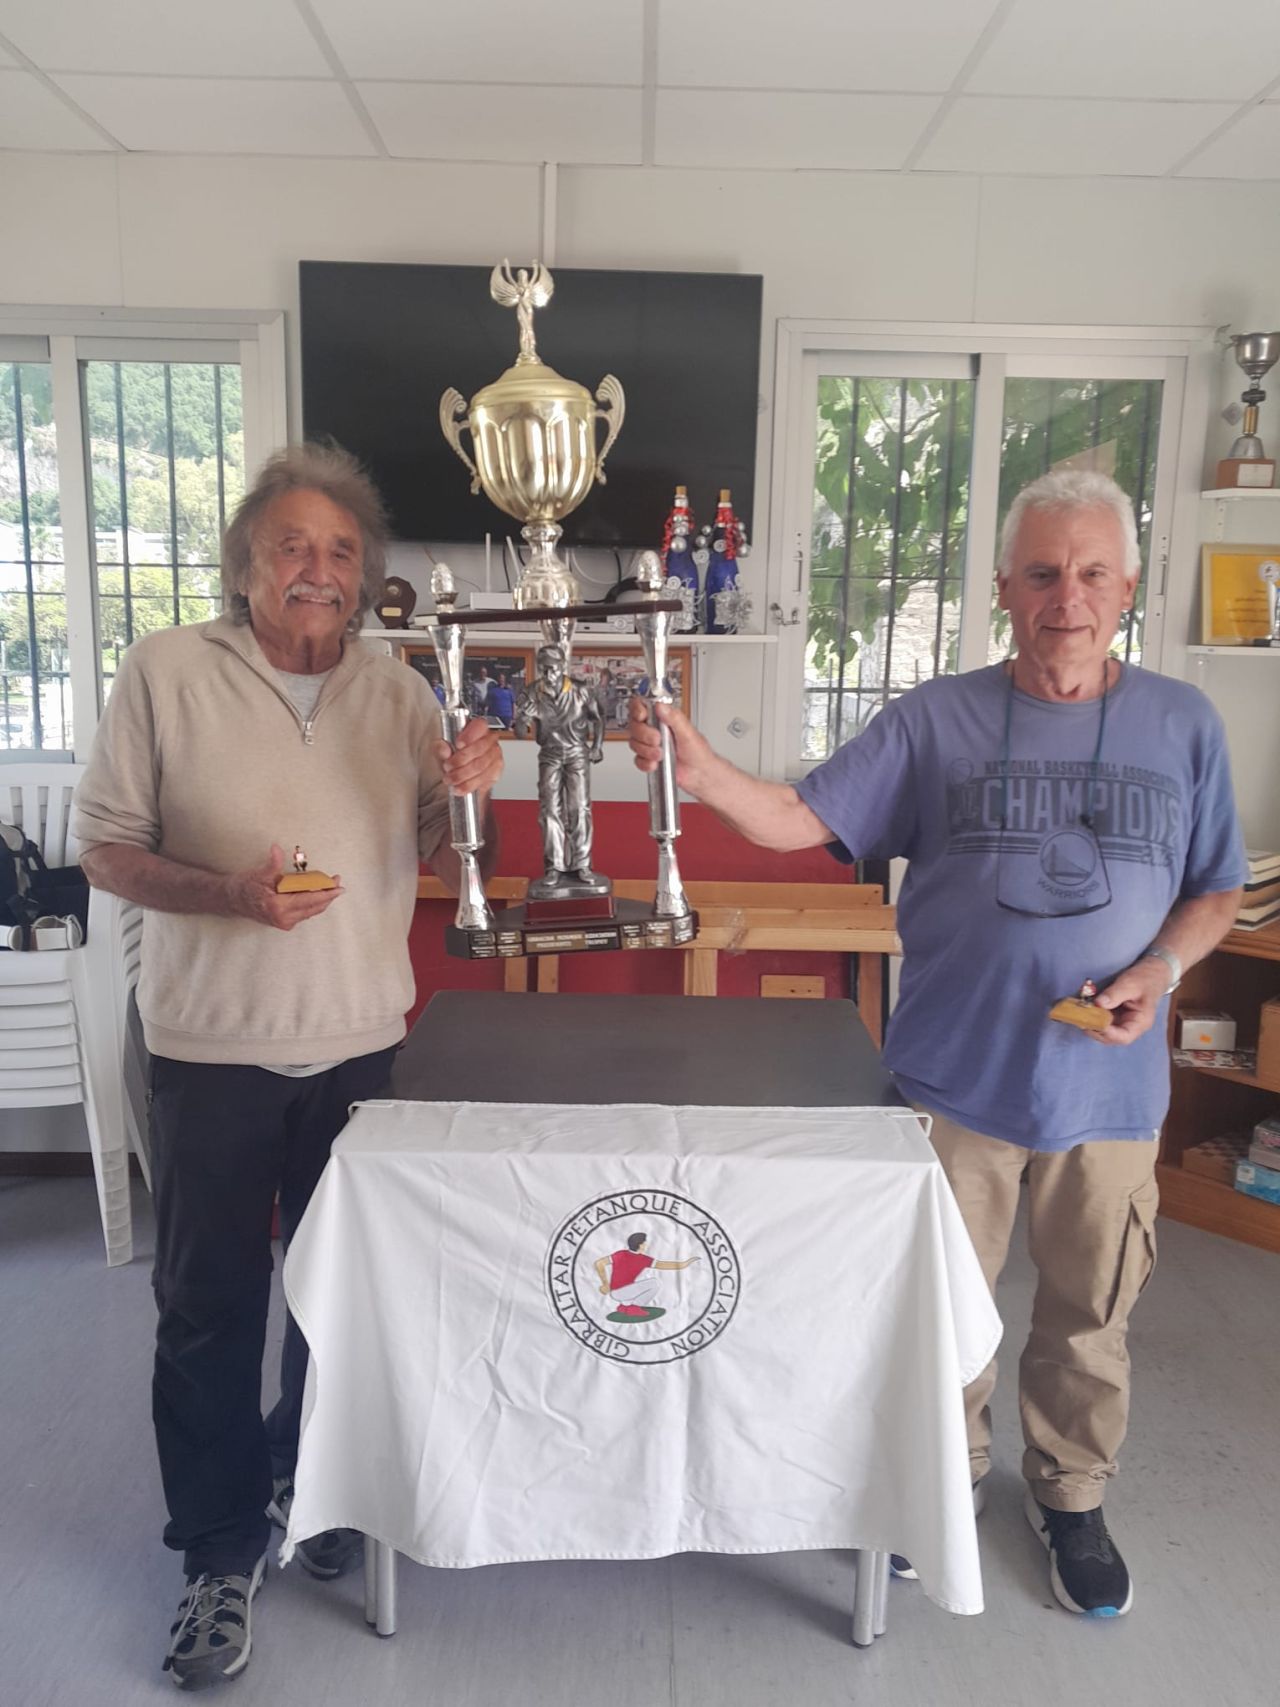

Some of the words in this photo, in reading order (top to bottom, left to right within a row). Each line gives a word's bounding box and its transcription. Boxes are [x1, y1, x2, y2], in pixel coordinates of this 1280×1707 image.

[982, 779, 1180, 847] CHAMPIONS
[1037, 878, 1100, 899] WARRIORS
[563, 1194, 682, 1246] PETANQUE
[552, 1254, 631, 1358] GIBRALTAR
[671, 1220, 736, 1356] ASSOCIATION
